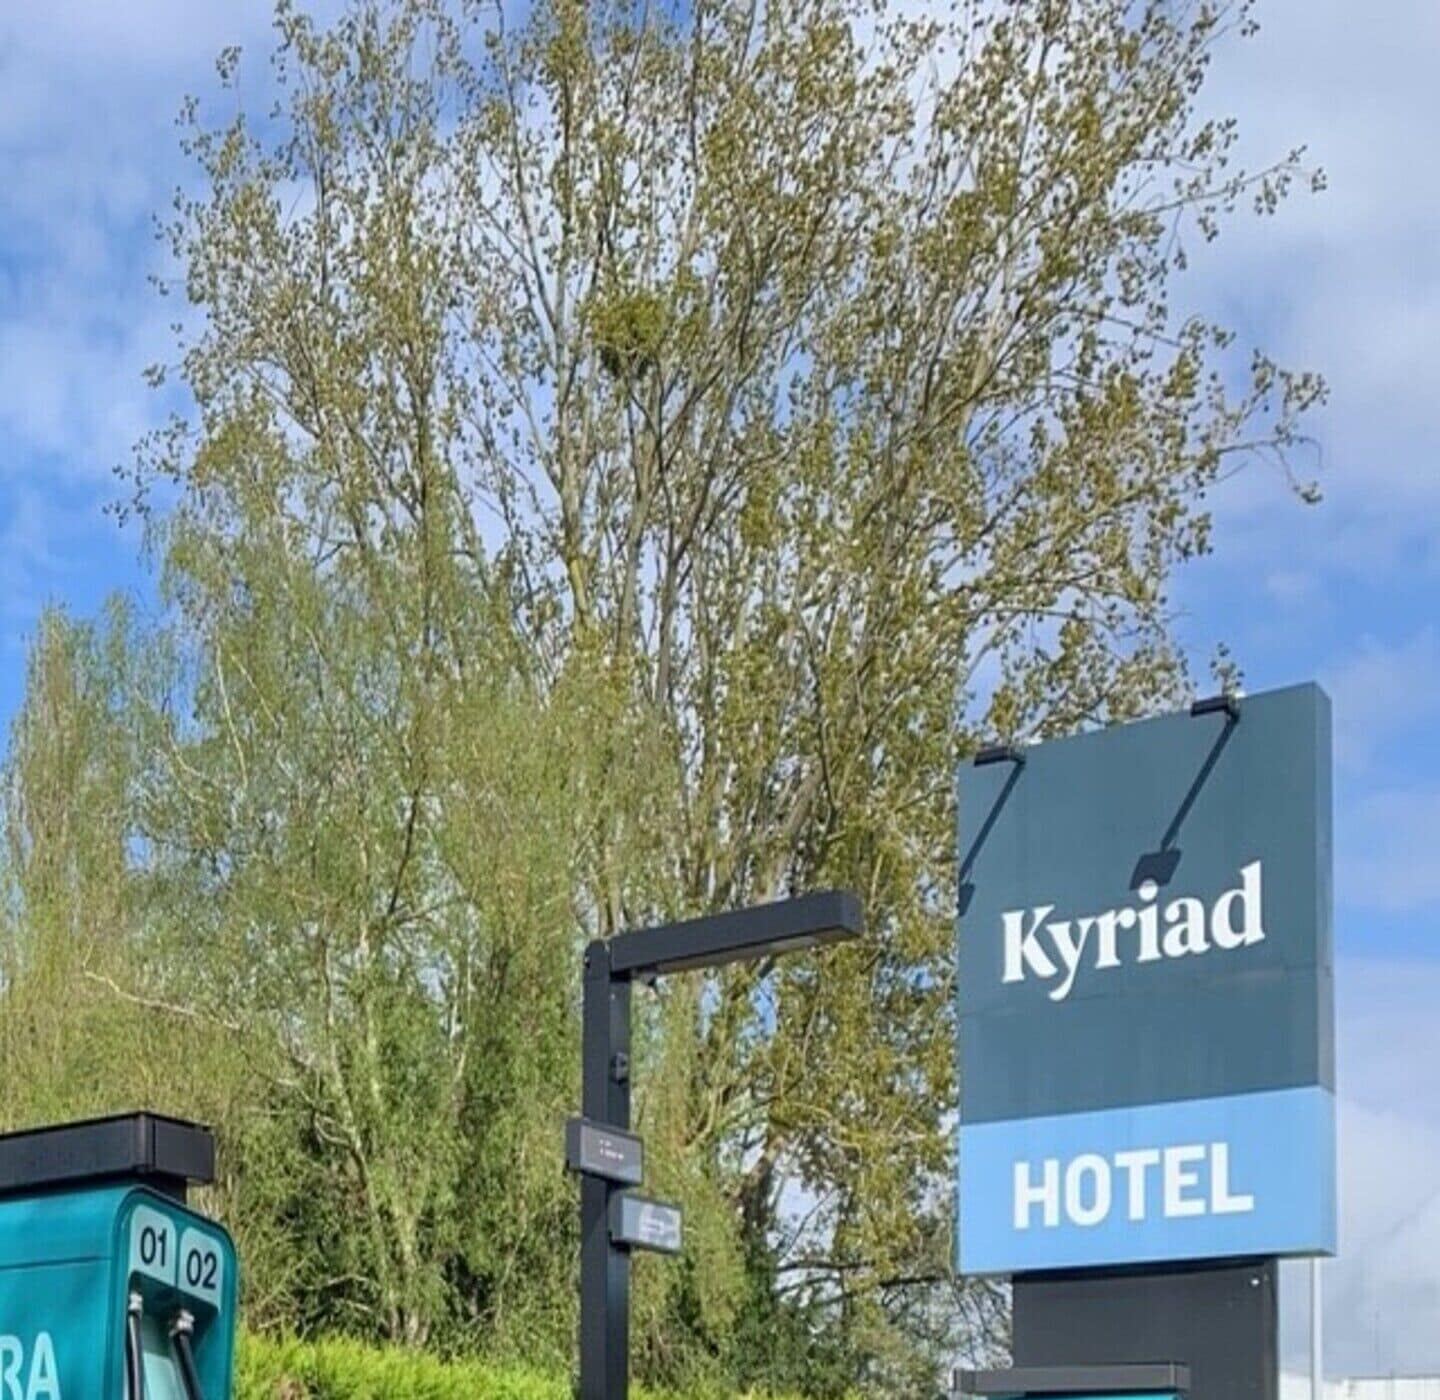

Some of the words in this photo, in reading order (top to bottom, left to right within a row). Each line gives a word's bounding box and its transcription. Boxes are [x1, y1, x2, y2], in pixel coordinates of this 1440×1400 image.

[1001, 860, 1265, 1001] Kyriad
[1012, 1141, 1255, 1230] HOTEL
[140, 1225, 167, 1268] 01
[186, 1248, 218, 1291] 02
